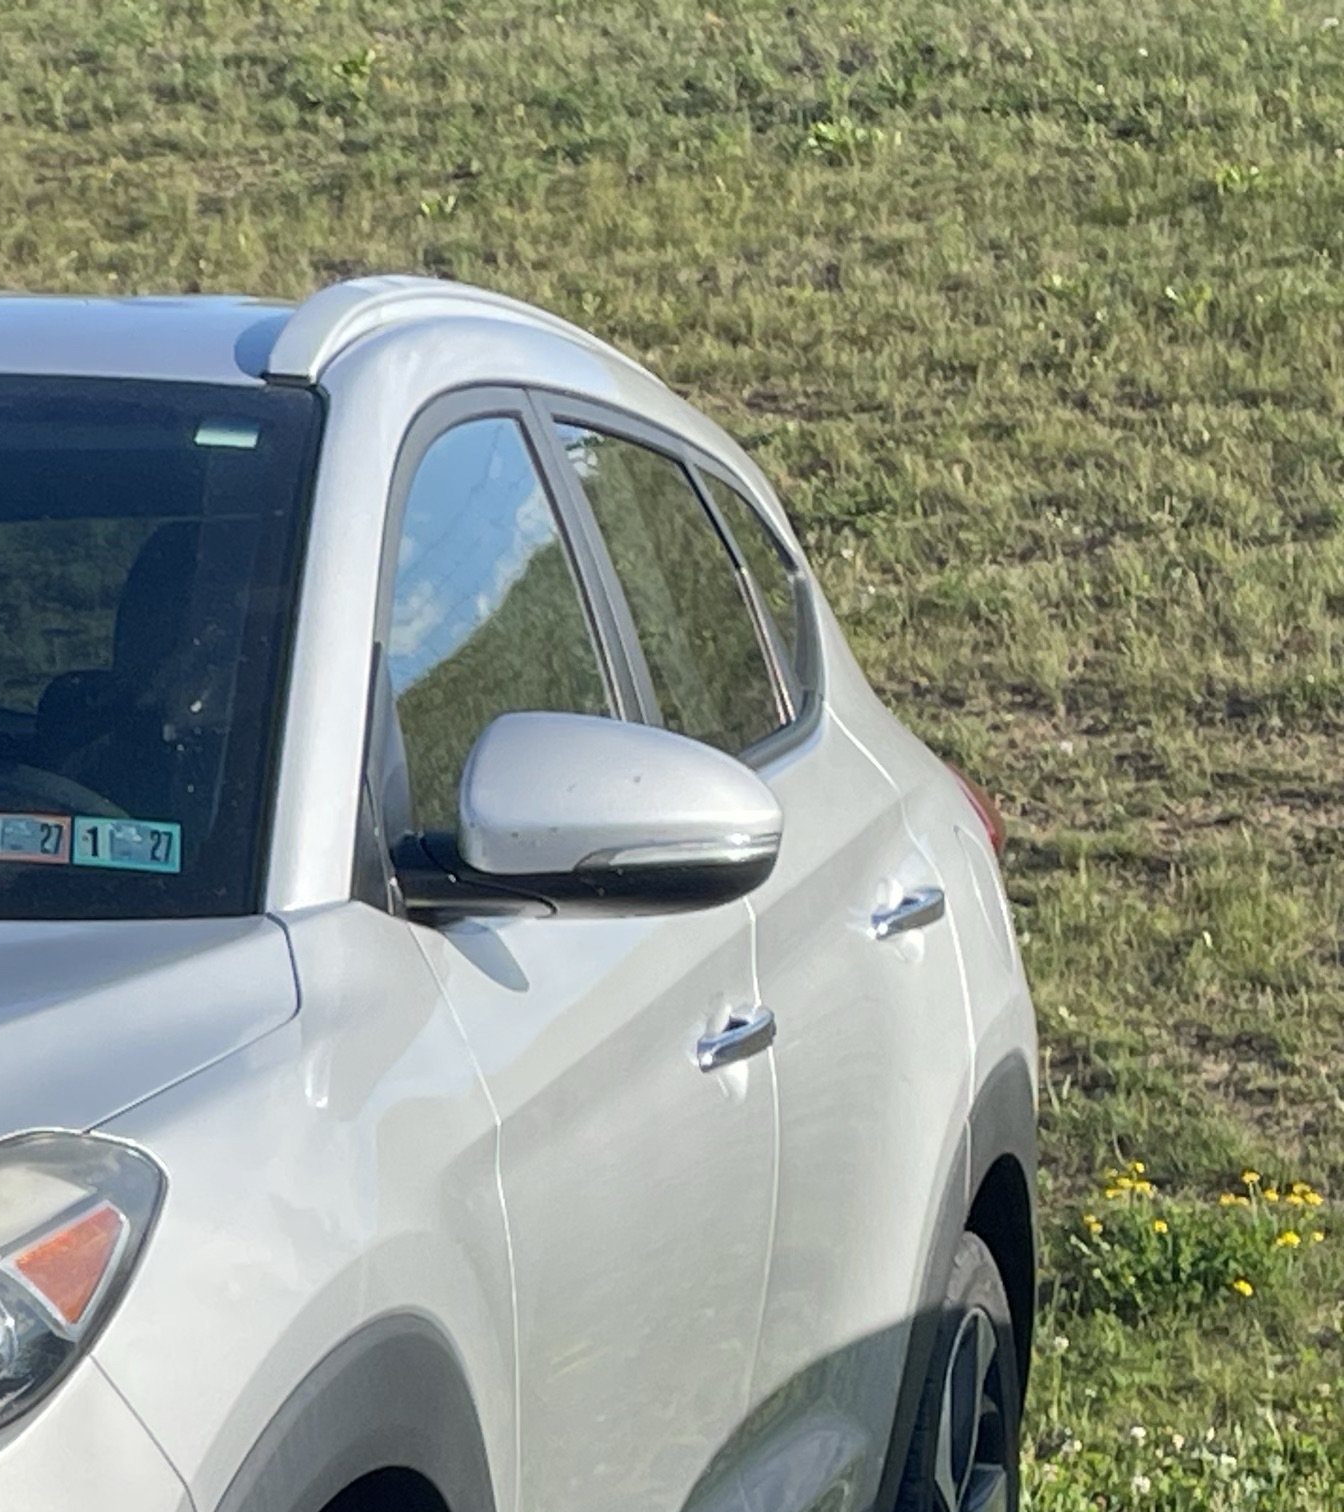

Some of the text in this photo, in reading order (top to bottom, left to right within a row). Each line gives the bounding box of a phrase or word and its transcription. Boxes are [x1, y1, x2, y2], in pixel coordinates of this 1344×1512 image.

[39, 823, 64, 854] 27
[86, 827, 173, 864] 1 27
